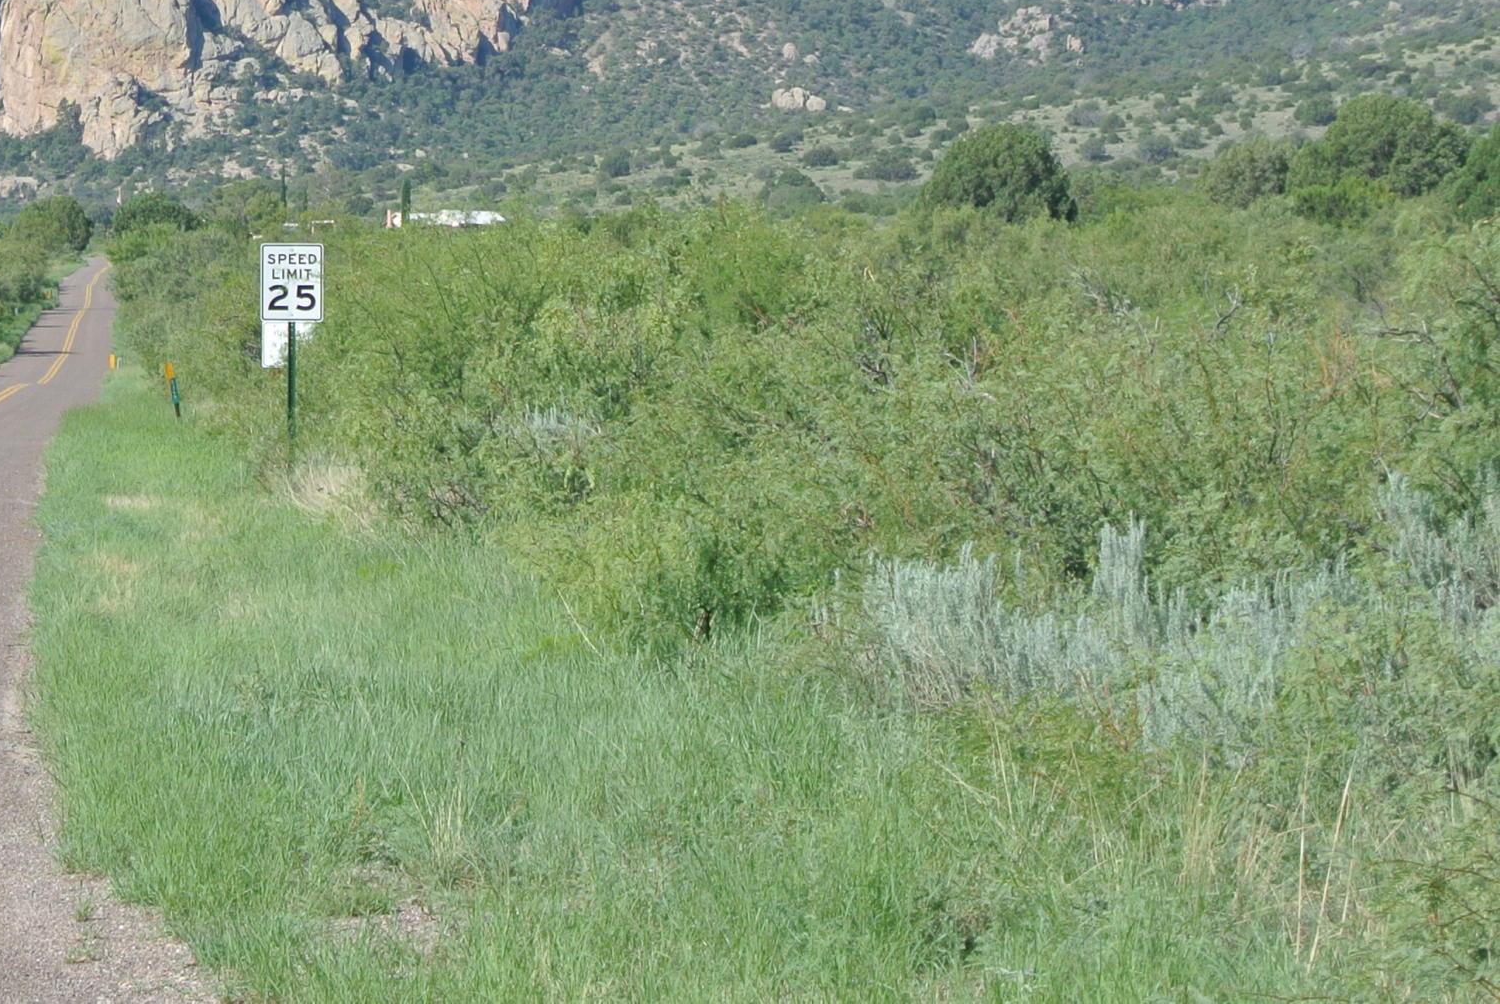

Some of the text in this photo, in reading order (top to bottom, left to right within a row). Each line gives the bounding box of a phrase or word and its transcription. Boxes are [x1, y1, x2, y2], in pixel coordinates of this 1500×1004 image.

[267, 253, 317, 265] SPEED
[272, 268, 312, 280] LIMIT
[268, 284, 316, 311] 25
